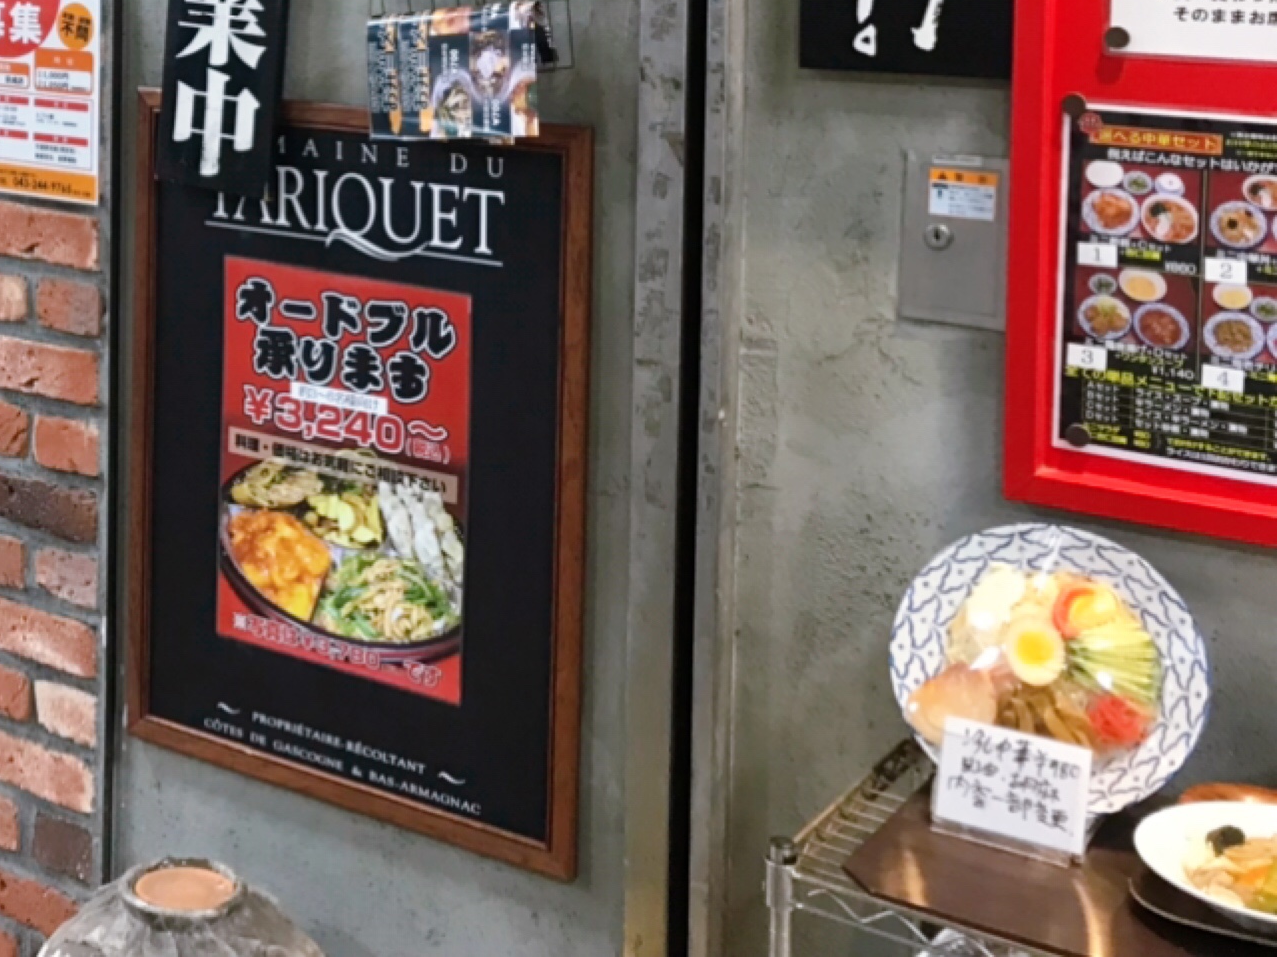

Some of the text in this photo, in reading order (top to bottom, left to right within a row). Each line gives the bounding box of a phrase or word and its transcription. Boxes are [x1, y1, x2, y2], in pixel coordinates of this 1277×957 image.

[450, 152, 505, 178] DU
[212, 164, 507, 259] RIQUET
[236, 277, 456, 360] オードブル
[273, 739, 344, 772] GASCOGNE
[368, 770, 482, 816] BAS-ARMAGNAC
